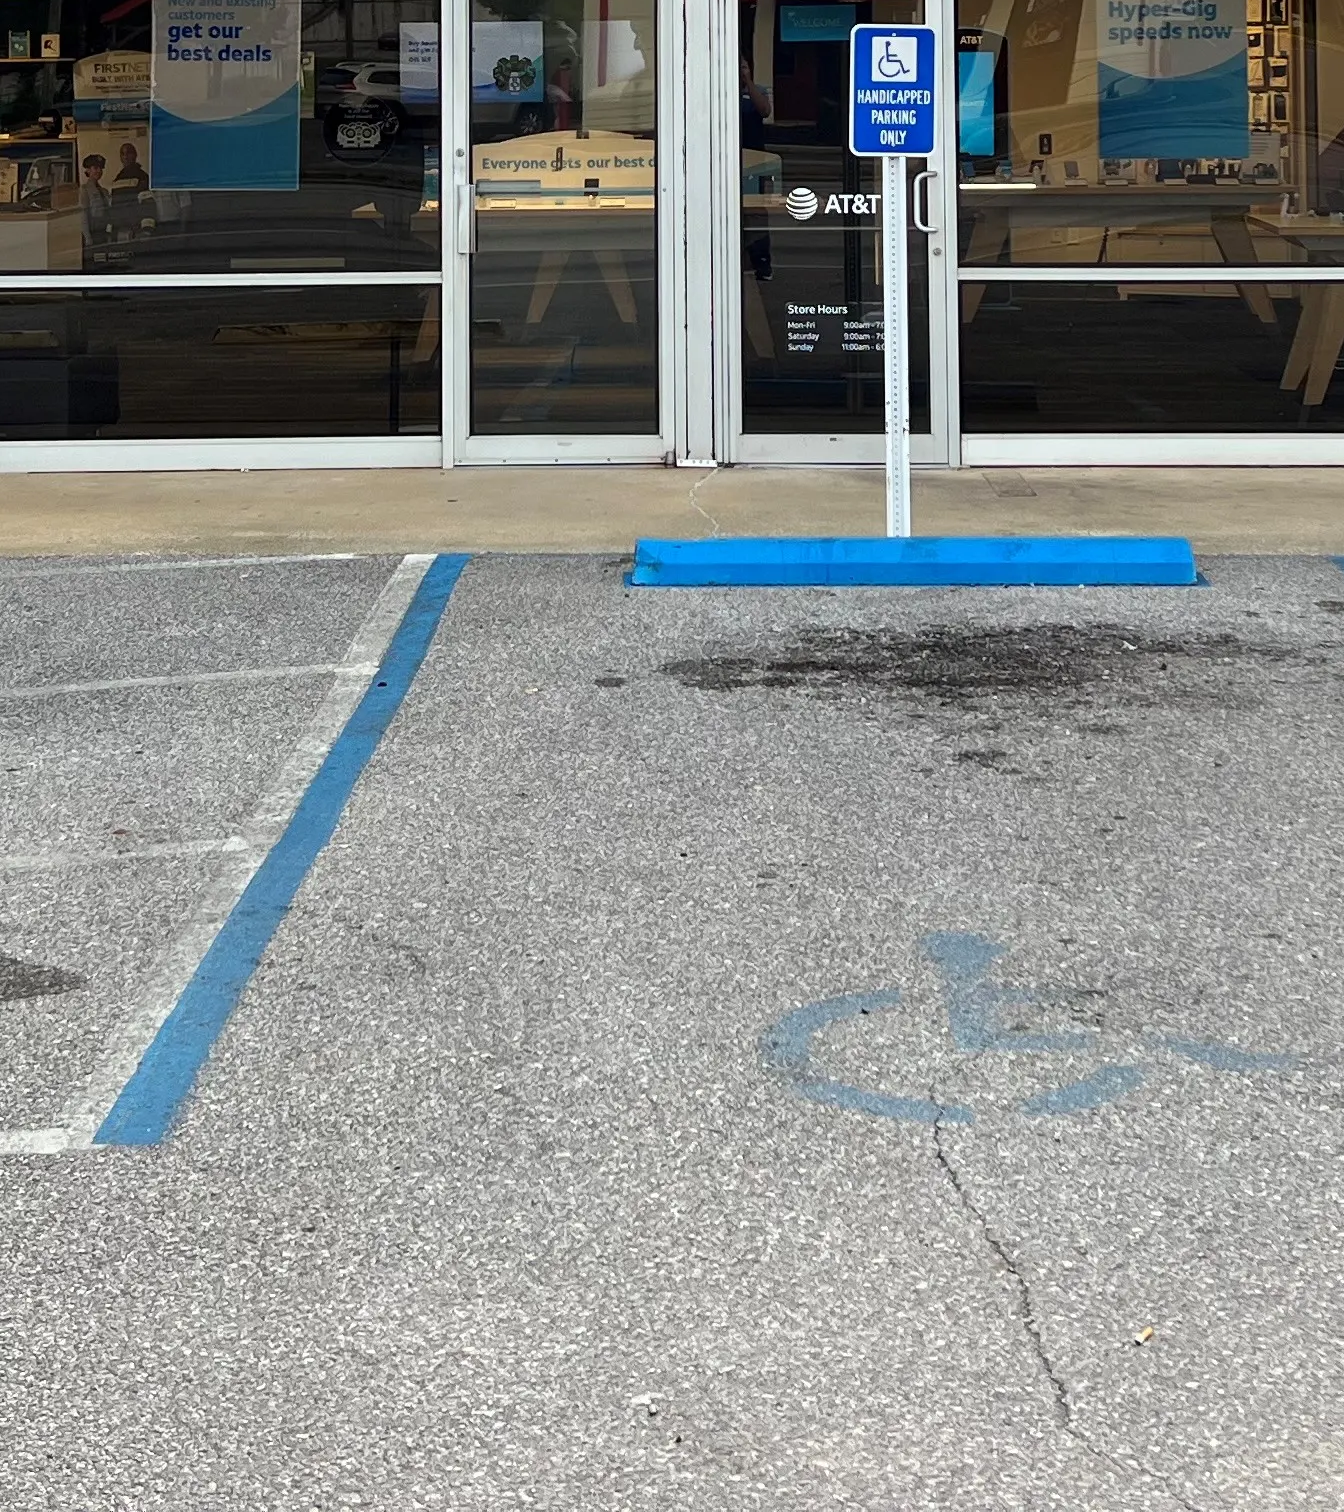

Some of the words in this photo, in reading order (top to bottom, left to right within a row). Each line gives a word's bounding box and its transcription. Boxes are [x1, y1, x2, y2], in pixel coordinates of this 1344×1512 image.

[168, 10, 235, 21] customers
[168, 23, 203, 43] get
[208, 25, 244, 39] our
[959, 35, 983, 45] AT&T
[1108, 21, 1182, 47] speeds
[1187, 25, 1234, 40] now
[167, 44, 213, 62] best
[217, 44, 272, 62] deals
[856, 89, 931, 105] HANDICAPPED
[871, 109, 917, 125] PARKING
[879, 129, 907, 145] ONLY
[482, 157, 547, 172] Everyone
[551, 158, 582, 172] gets
[587, 158, 611, 168] our
[614, 155, 645, 168] best
[824, 193, 882, 215] AT&T
[787, 304, 816, 315] Store
[817, 304, 848, 315] Hours
[787, 321, 816, 329] Mon-Fri
[843, 321, 870, 329] 9:00am
[787, 332, 820, 341] Saturday
[843, 332, 870, 341] 9:00am
[787, 343, 814, 352] Sunday
[841, 343, 870, 351] 11:00am
